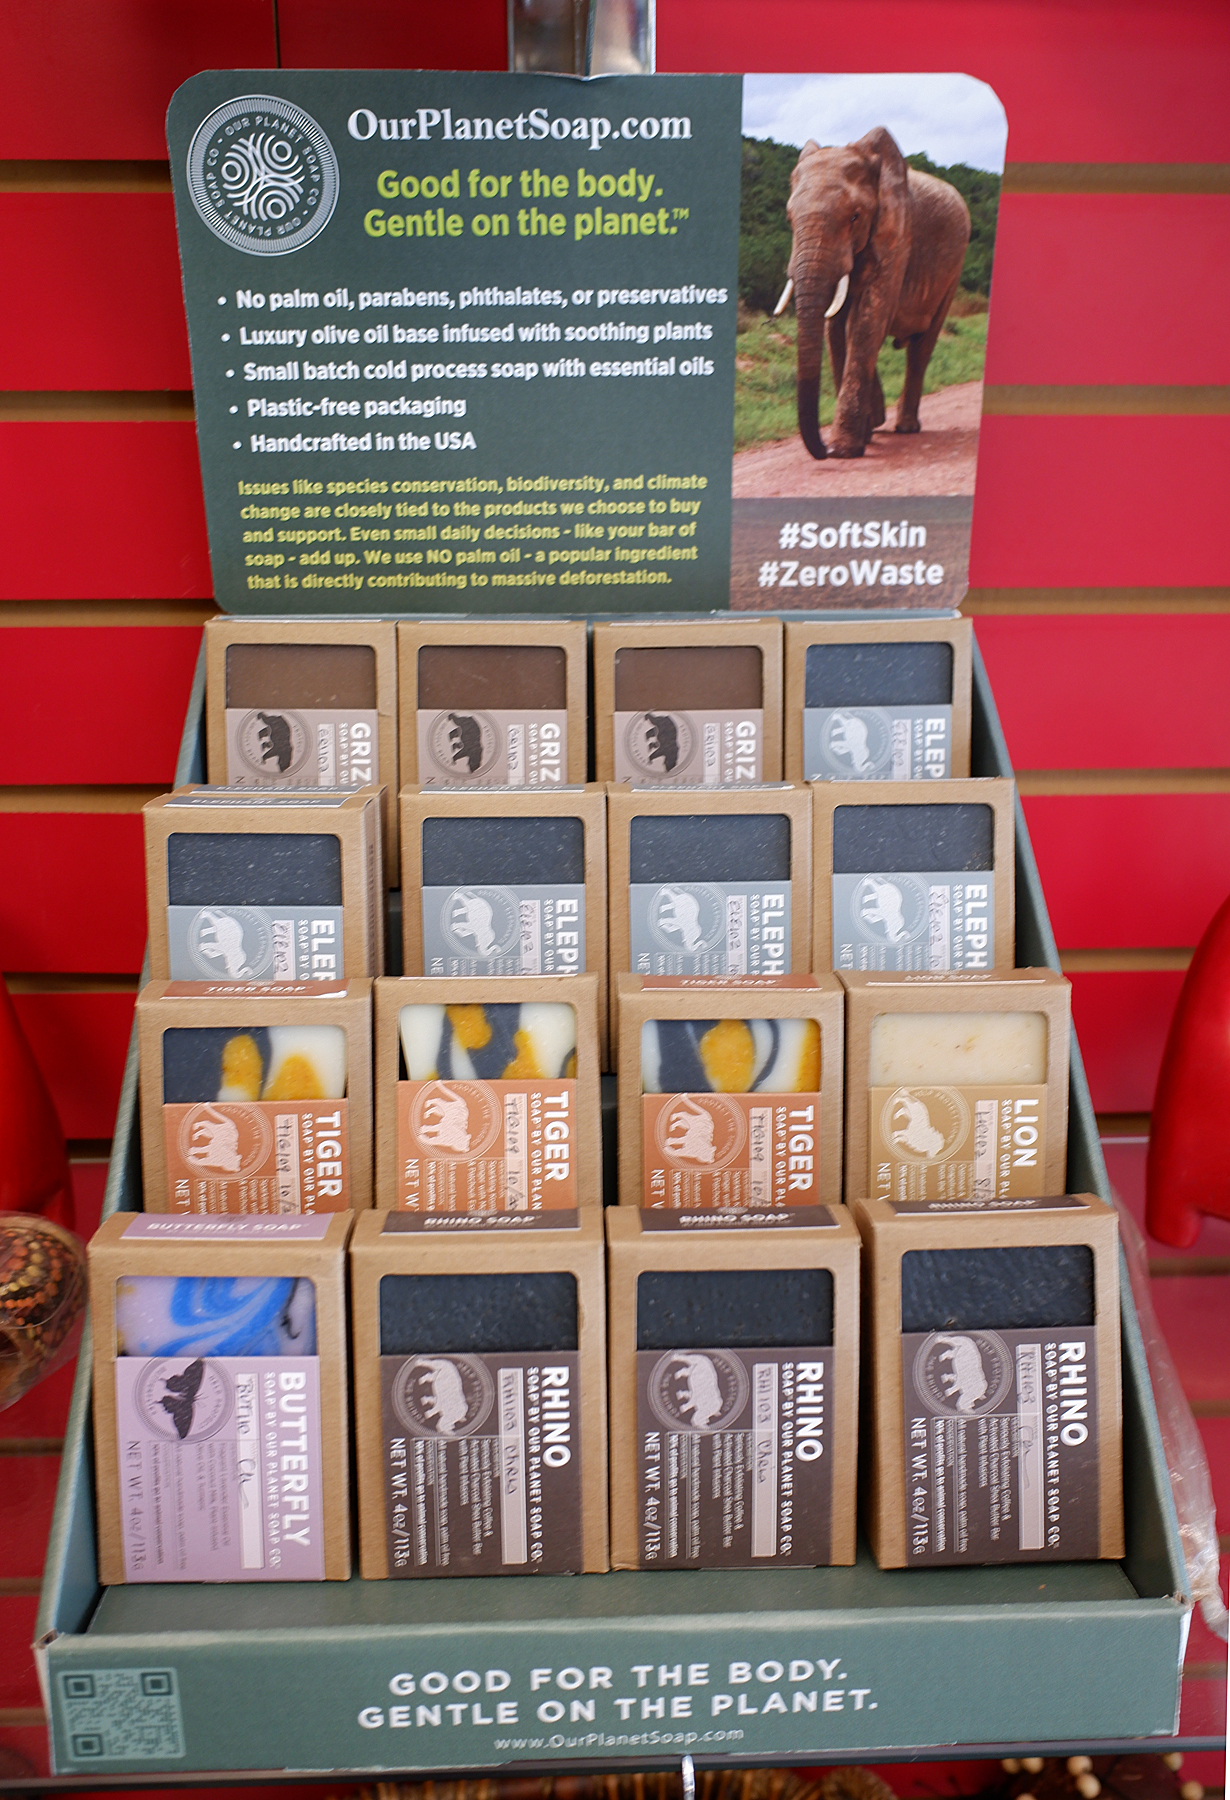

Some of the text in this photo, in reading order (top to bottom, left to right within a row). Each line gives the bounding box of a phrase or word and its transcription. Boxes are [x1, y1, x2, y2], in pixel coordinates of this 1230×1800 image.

[255, 115, 305, 143] PLANET
[347, 108, 693, 151] OurPlanetSoap.com
[377, 167, 664, 203] Good for the body.
[364, 208, 464, 238] Gentle
[471, 214, 510, 237] on
[517, 207, 567, 237] the
[236, 284, 729, 312] No palm oil, parabens, phthalates, or preservatives
[239, 321, 714, 348] Luxury olive oil base infused with soothing plants
[243, 356, 715, 383] Small batch cold process soap with essential oils
[247, 396, 467, 419] Plastic-free packaging
[250, 431, 478, 453] Handcrafted in the USA
[238, 474, 708, 497] Issues like species conservation, biodiversity, and climate
[240, 498, 702, 522] change are closely tied to the products we choose to buy
[243, 527, 275, 543] and
[277, 527, 347, 545] support.
[350, 526, 391, 542] Even
[393, 525, 438, 541] small
[440, 525, 482, 543] daily
[483, 524, 561, 540] decisions
[574, 523, 605, 539] like
[607, 525, 646, 541] your
[648, 522, 677, 538] bar
[678, 521, 698, 538] of
[778, 520, 927, 550] #SoftSkin
[245, 554, 286, 569] soap
[299, 550, 332, 566] add
[334, 553, 361, 568] up.
[363, 550, 392, 565] We
[394, 552, 424, 565] use
[426, 549, 453, 564] NO
[455, 548, 497, 567] palm
[499, 547, 521, 564] oil
[535, 550, 546, 563] a
[548, 546, 613, 565] popular
[614, 545, 699, 564] ingredient
[247, 569, 673, 591] that is directly contributing to massive deforestation.
[758, 559, 945, 588] #ZeroWaste
[349, 722, 371, 787] GRIZ
[735, 721, 756, 780] GRIZ
[761, 894, 785, 976] ELEPH
[964, 884, 988, 968] ELEPH
[543, 1091, 569, 1182] TIGER
[788, 1105, 814, 1191] TIGER
[1012, 1099, 1039, 1167] LION
[315, 1110, 342, 1197] TIGER
[1045, 1383, 1058, 1401] BY
[1056, 1341, 1088, 1447] RHINO
[527, 1407, 540, 1424] BY
[541, 1366, 571, 1468] RHINO
[781, 1401, 794, 1418] BY
[795, 1362, 824, 1462] RHINO
[1045, 1404, 1059, 1432] OUR
[527, 1427, 541, 1454] OUR
[644, 1432, 660, 1463] NET
[781, 1421, 794, 1448] OUR
[910, 1417, 927, 1450] NET
[278, 1372, 310, 1545] BUTTERFLY
[389, 1438, 407, 1469] NET
[1046, 1435, 1060, 1485] PLANET
[528, 1457, 542, 1504] PLANET
[780, 1451, 794, 1498] PLANET
[780, 1500, 793, 1532] SOAP
[1047, 1488, 1060, 1523] SOAP
[529, 1507, 542, 1539] SOAP
[389, 1658, 848, 1696] GOOD FOR THE BODY.
[358, 1688, 878, 1729] GENTLE ON THE PLANET.
[494, 1729, 745, 1750] www.OurPlanetSoap.com
